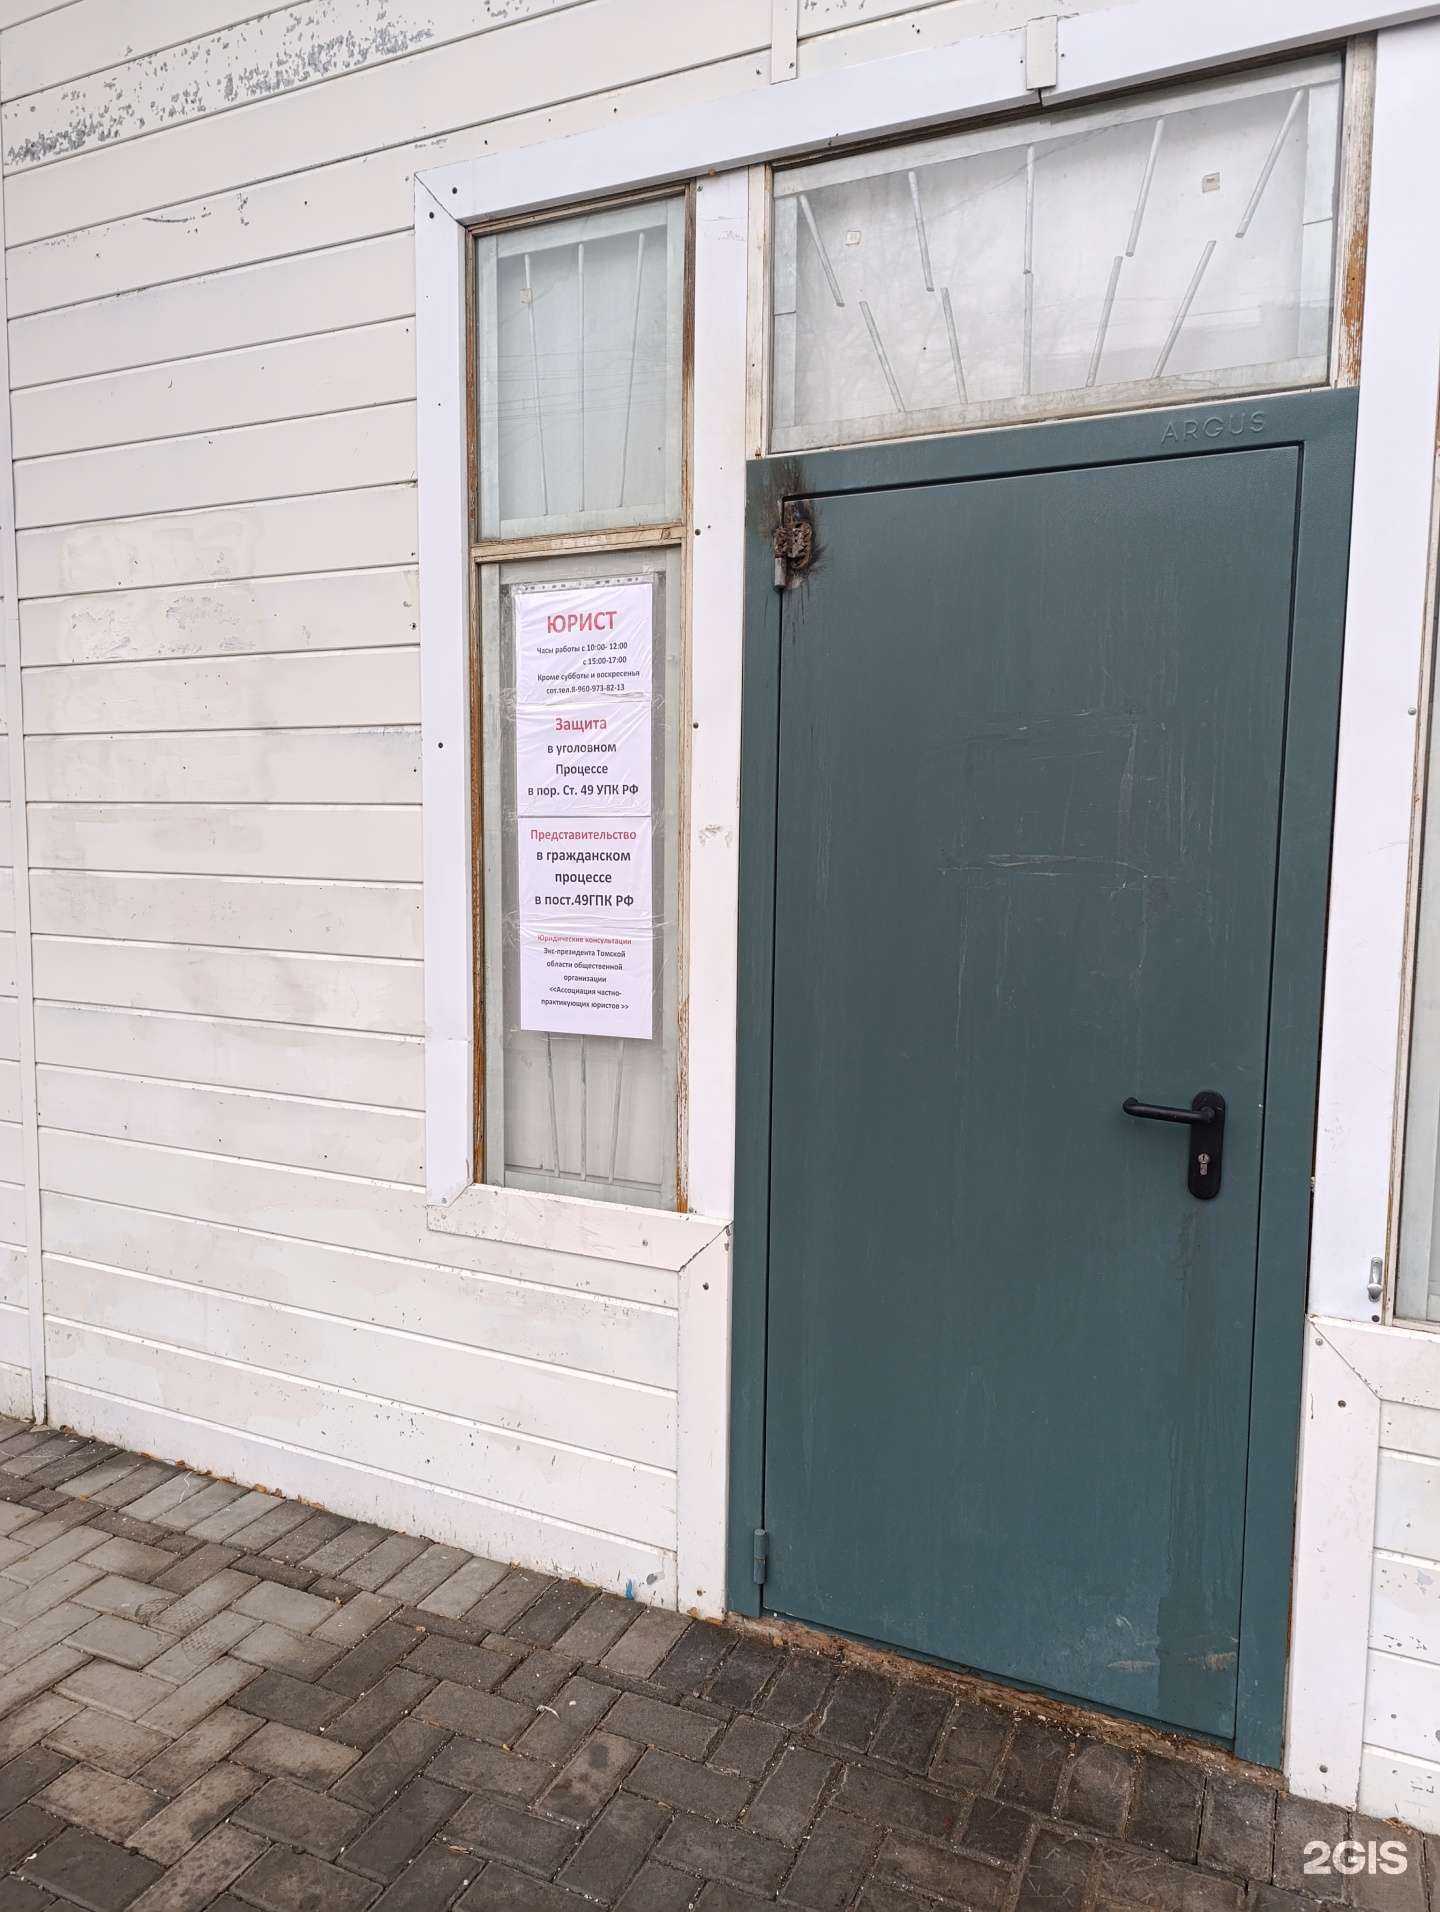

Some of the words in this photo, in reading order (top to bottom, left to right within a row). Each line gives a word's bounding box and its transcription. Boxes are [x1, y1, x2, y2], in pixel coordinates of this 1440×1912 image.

[1160, 411, 1266, 444] ARGUS
[547, 611, 617, 633] ЮРИСТ
[537, 646, 553, 654] Часы
[555, 644, 580, 655] работы
[609, 641, 628, 650] 12:00
[588, 656, 627, 665] 15:00-17:00
[537, 673, 560, 682] Кроме
[561, 671, 590, 682] субботы
[596, 670, 640, 680] воскресенья
[555, 717, 607, 732] Защита
[547, 745, 553, 753] в
[556, 743, 617, 756] уголовном
[555, 763, 608, 776] Процессе
[528, 787, 534, 796] в
[537, 786, 560, 798] пор.
[563, 785, 578, 796] Ст.
[580, 785, 594, 795] 49
[596, 784, 619, 795] УПК
[622, 784, 639, 795] РФ
[530, 829, 637, 842] Представительство
[536, 852, 543, 861] в
[546, 851, 631, 863] гражданском
[555, 873, 612, 885] процессе
[535, 896, 541, 904] в
[545, 894, 612, 906] пост.49ГПК
[616, 895, 634, 907] РФ
[537, 934, 584, 945] Юридические
[585, 937, 632, 946] консультации
[597, 949, 626, 958] Томской
[546, 960, 572, 968] области
[573, 961, 623, 971] общественной
[563, 974, 607, 983] организации
[597, 989, 622, 997] частно-
[541, 998, 590, 1008] практикующих
[591, 1001, 620, 1010] юристов
